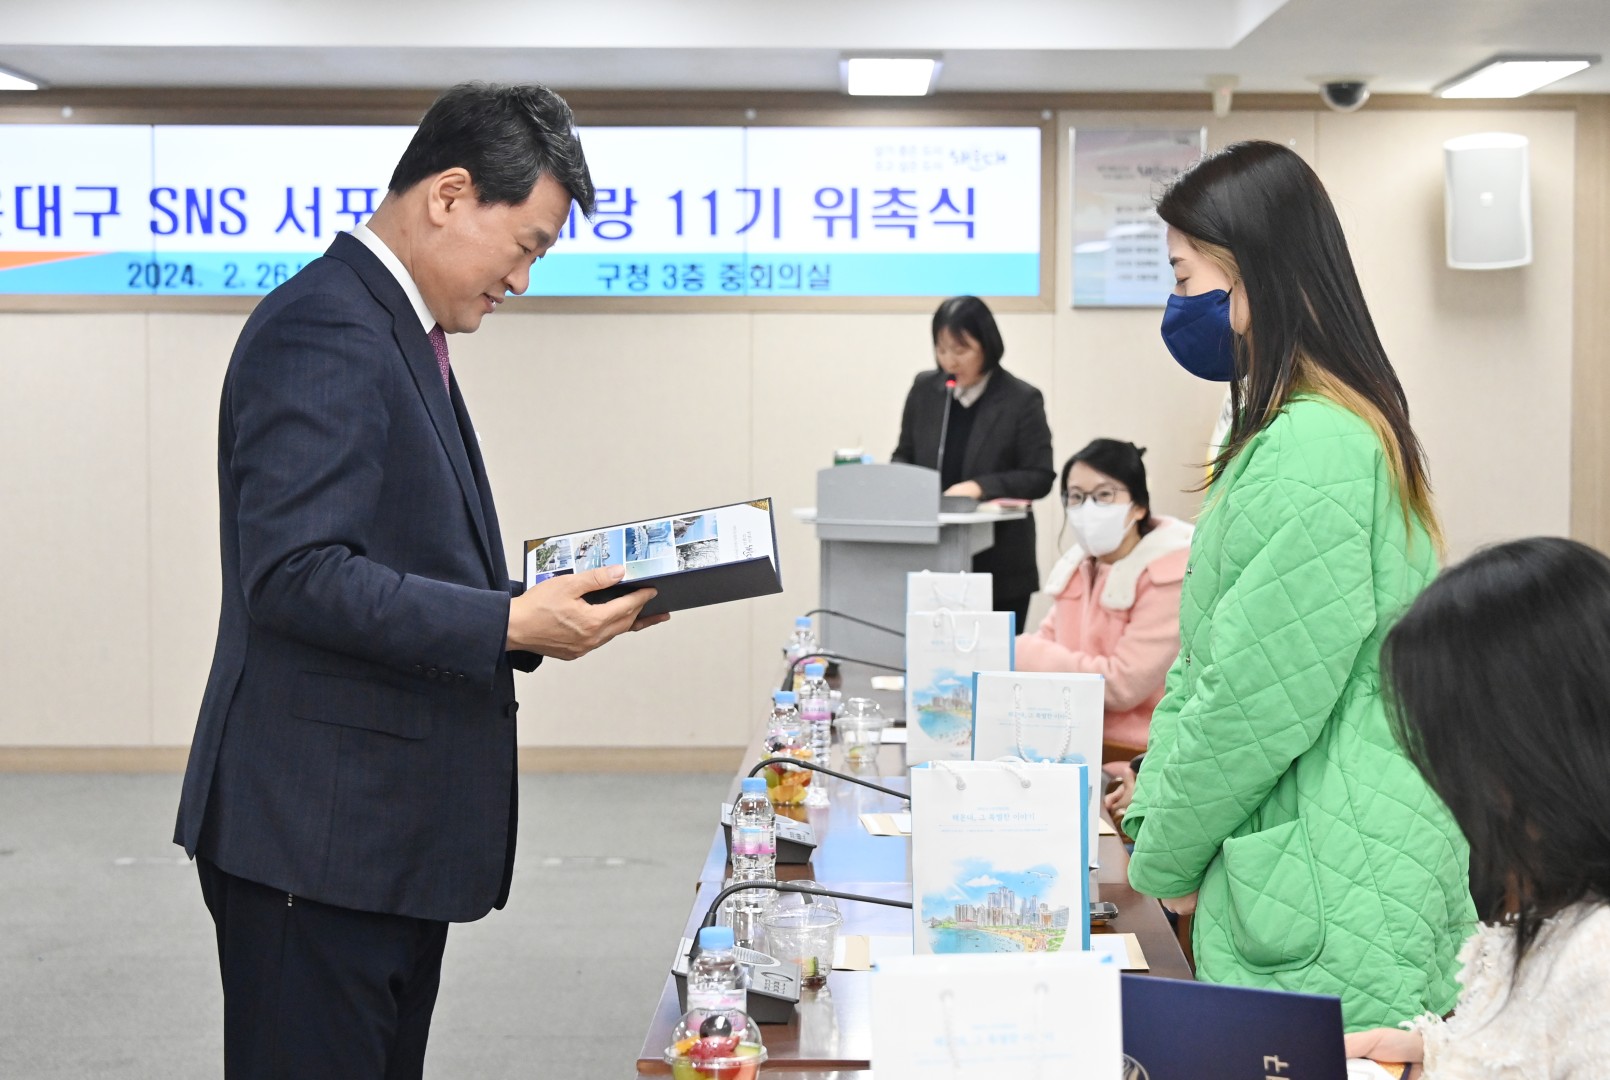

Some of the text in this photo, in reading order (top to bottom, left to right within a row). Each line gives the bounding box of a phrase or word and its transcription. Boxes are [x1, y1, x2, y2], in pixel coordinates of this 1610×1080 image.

[0, 185, 120, 237] 대구
[149, 187, 247, 235] SNS
[275, 186, 378, 237] 서포
[667, 187, 781, 239] 11기
[813, 187, 975, 239] 위촉식
[127, 263, 203, 288] 2024.
[256, 263, 303, 288] 26
[598, 263, 831, 291] 구청 3층 중회의실
